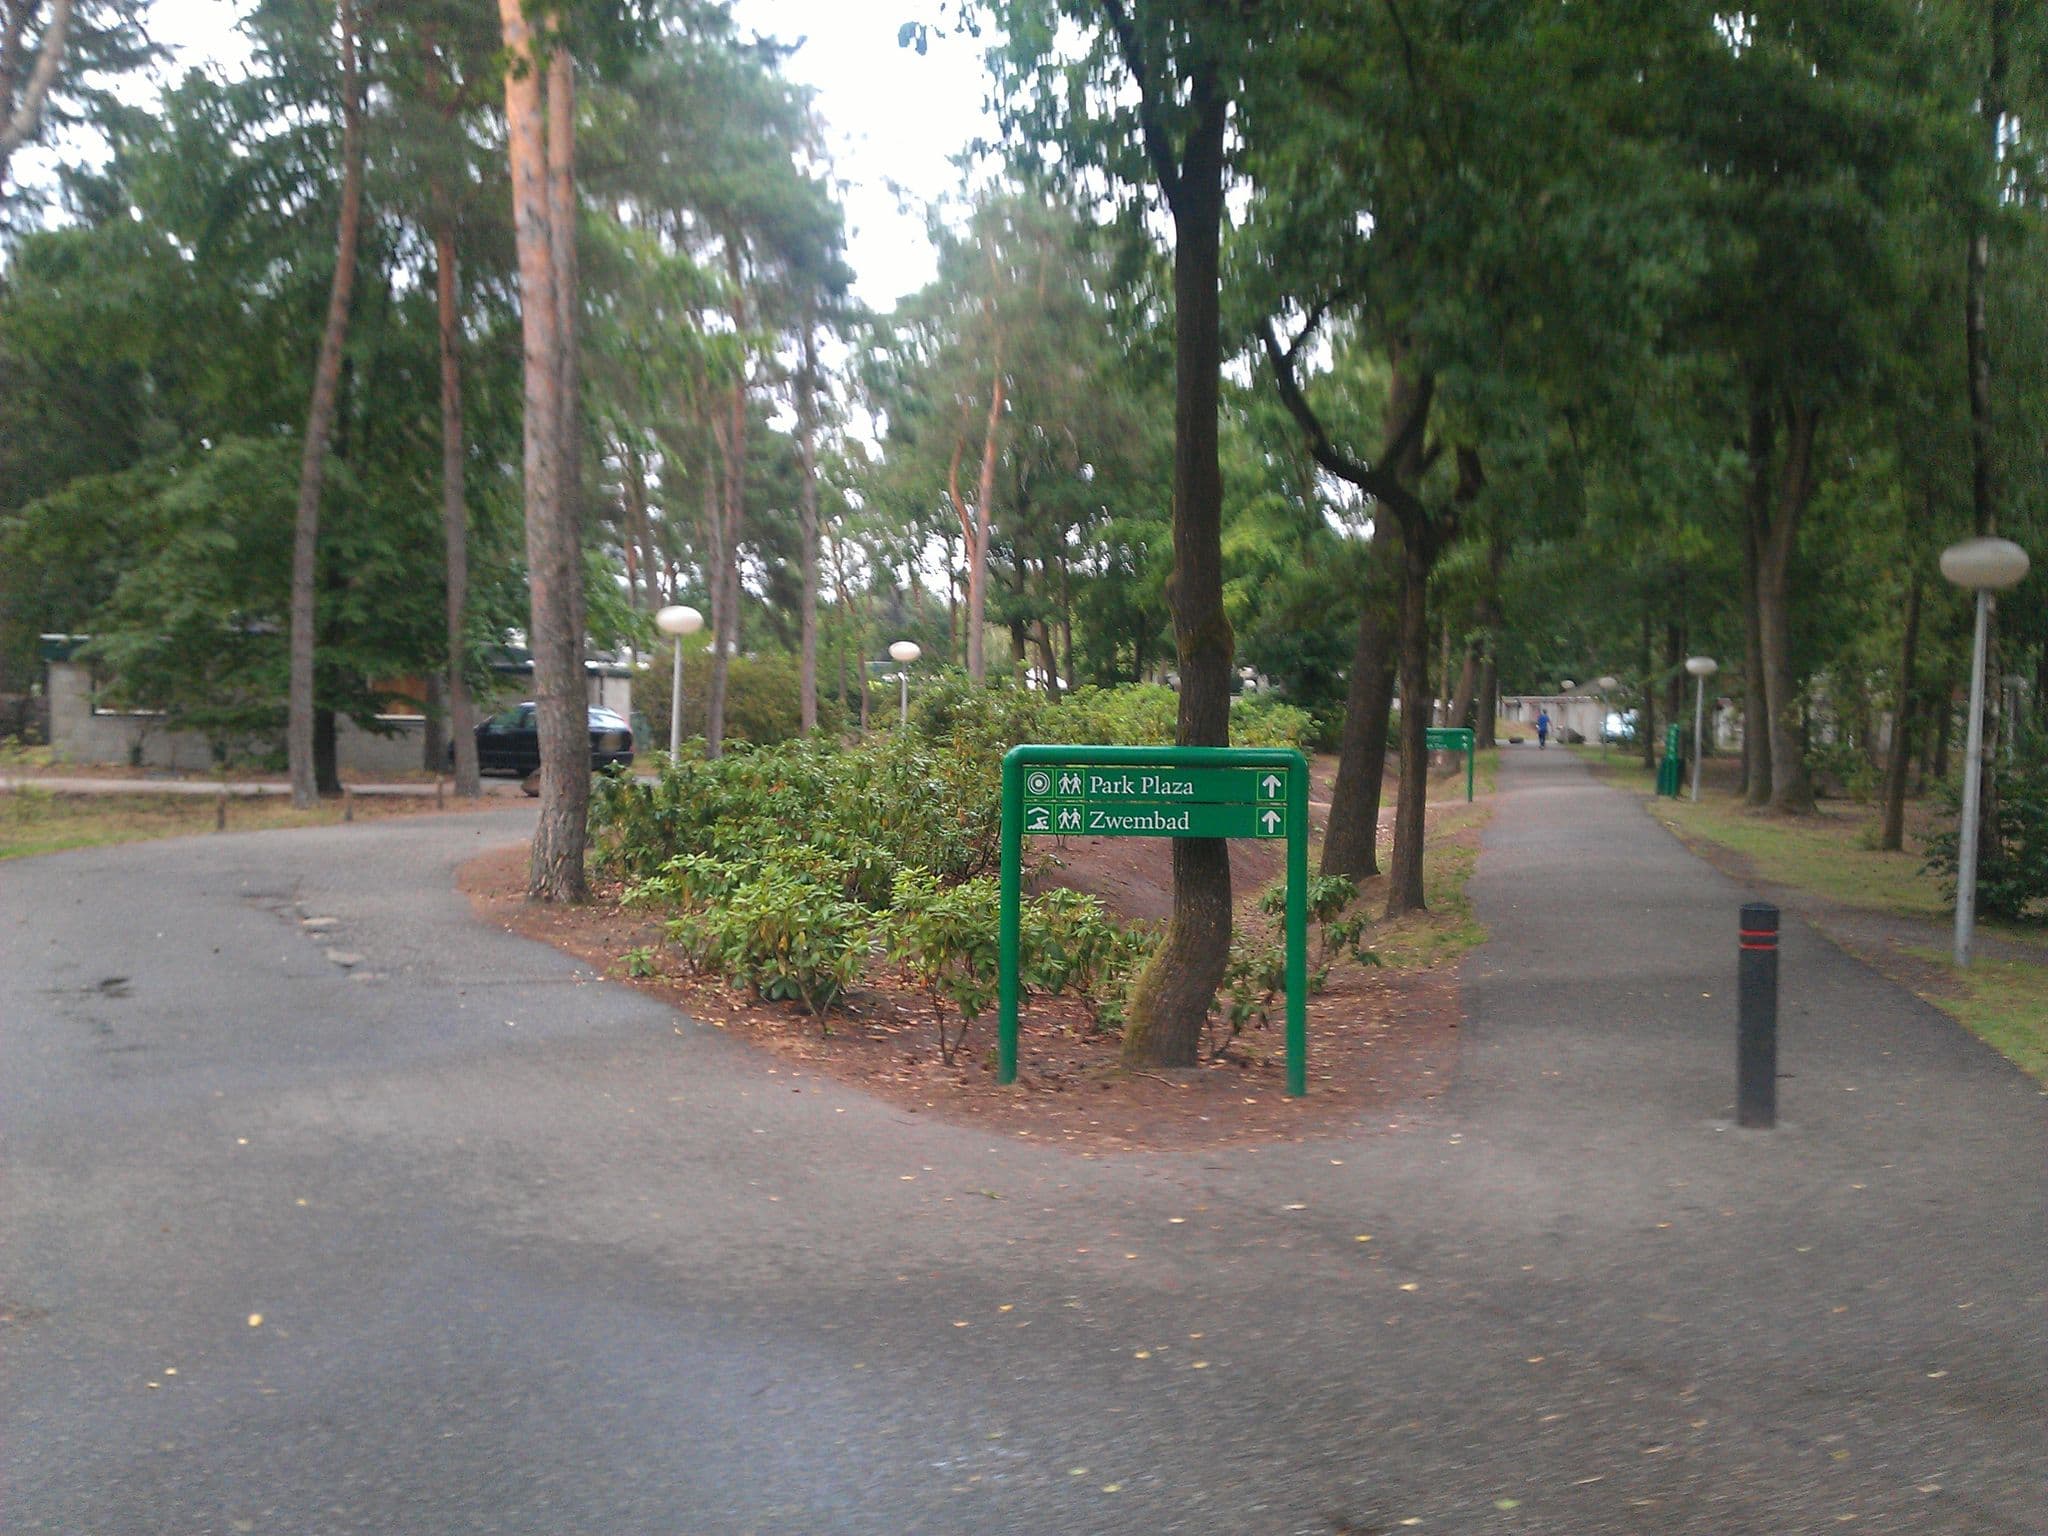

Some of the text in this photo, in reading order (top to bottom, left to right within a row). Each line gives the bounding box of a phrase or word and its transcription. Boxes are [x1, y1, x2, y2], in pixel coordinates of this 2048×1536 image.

[1089, 775, 1194, 795] Park Plaza
[1089, 811, 1190, 830] Zwembad
